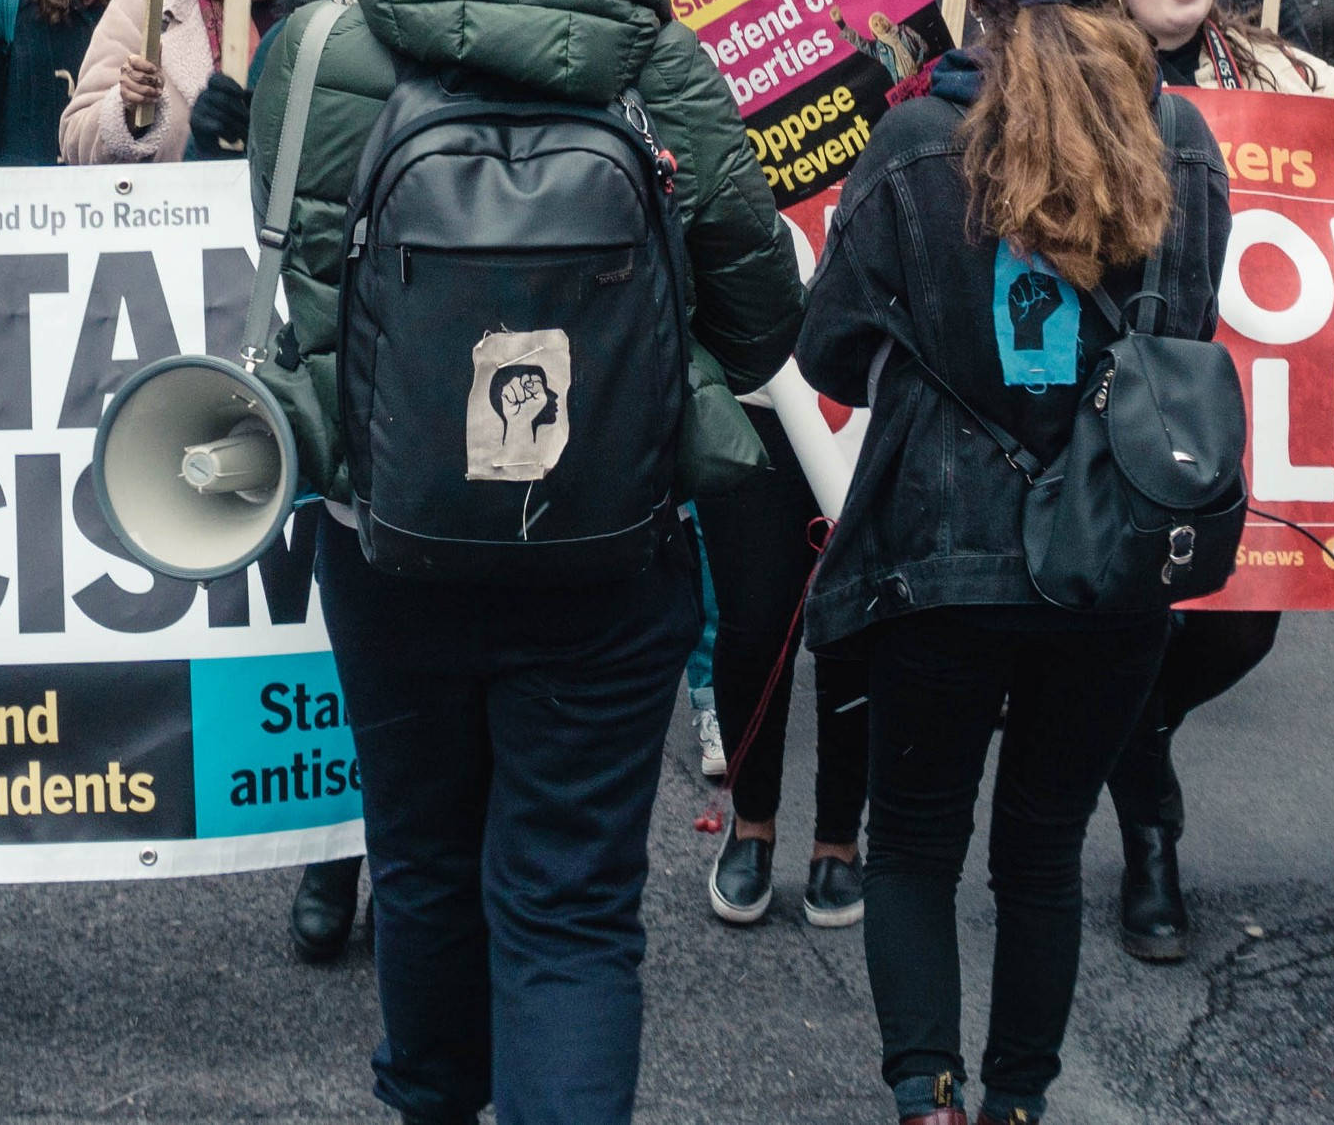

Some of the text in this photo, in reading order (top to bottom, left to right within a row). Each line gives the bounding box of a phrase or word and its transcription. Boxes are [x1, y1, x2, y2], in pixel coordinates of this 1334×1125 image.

[744, 85, 856, 161] Oppose
[31, 203, 67, 238] Up
[75, 201, 106, 231] To
[113, 200, 210, 229] Racism
